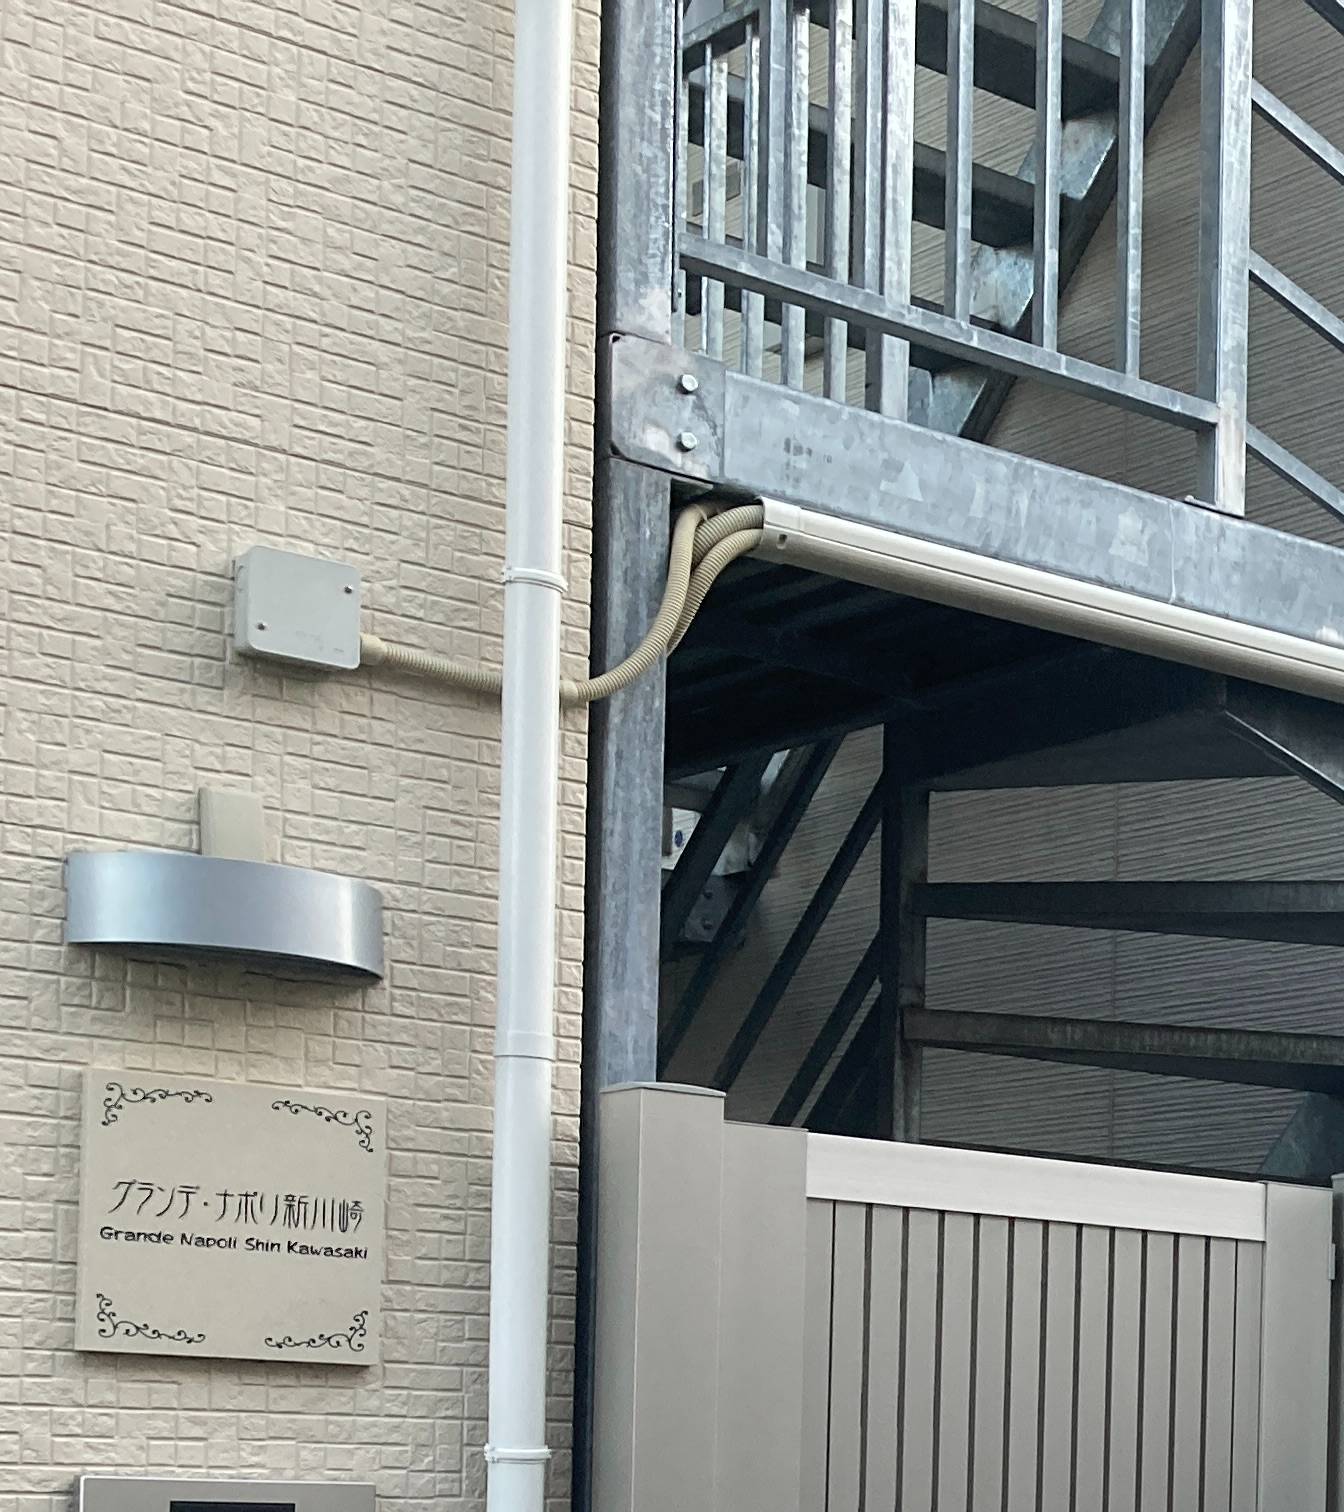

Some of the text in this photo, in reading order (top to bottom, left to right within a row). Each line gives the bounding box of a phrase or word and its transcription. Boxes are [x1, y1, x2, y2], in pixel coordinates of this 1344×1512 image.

[99, 1226, 369, 1259] Grande Napoli Shin Kawasaki
